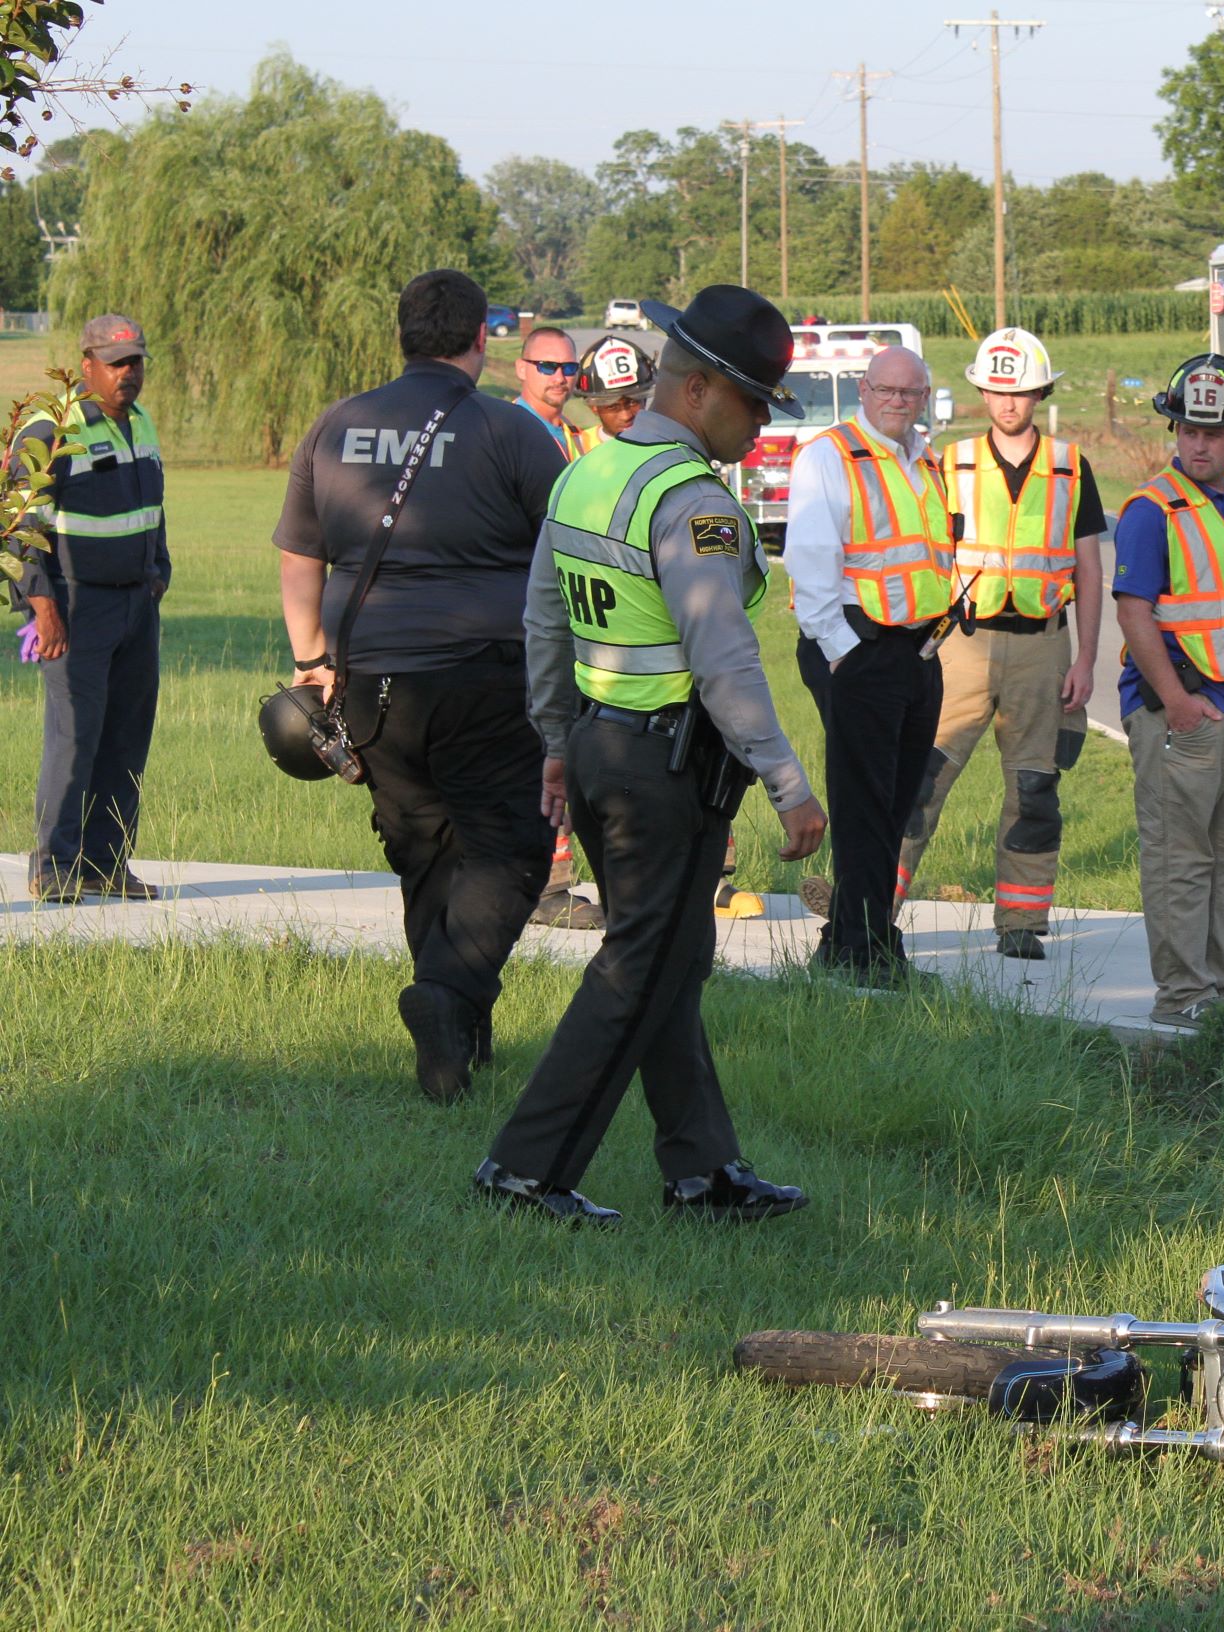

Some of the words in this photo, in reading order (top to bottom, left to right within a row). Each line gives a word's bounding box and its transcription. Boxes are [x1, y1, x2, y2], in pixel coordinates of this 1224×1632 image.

[991, 355, 1015, 375] 16
[1193, 388, 1217, 406] 16
[341, 428, 456, 468] EMT
[392, 409, 445, 505] THOMPSON
